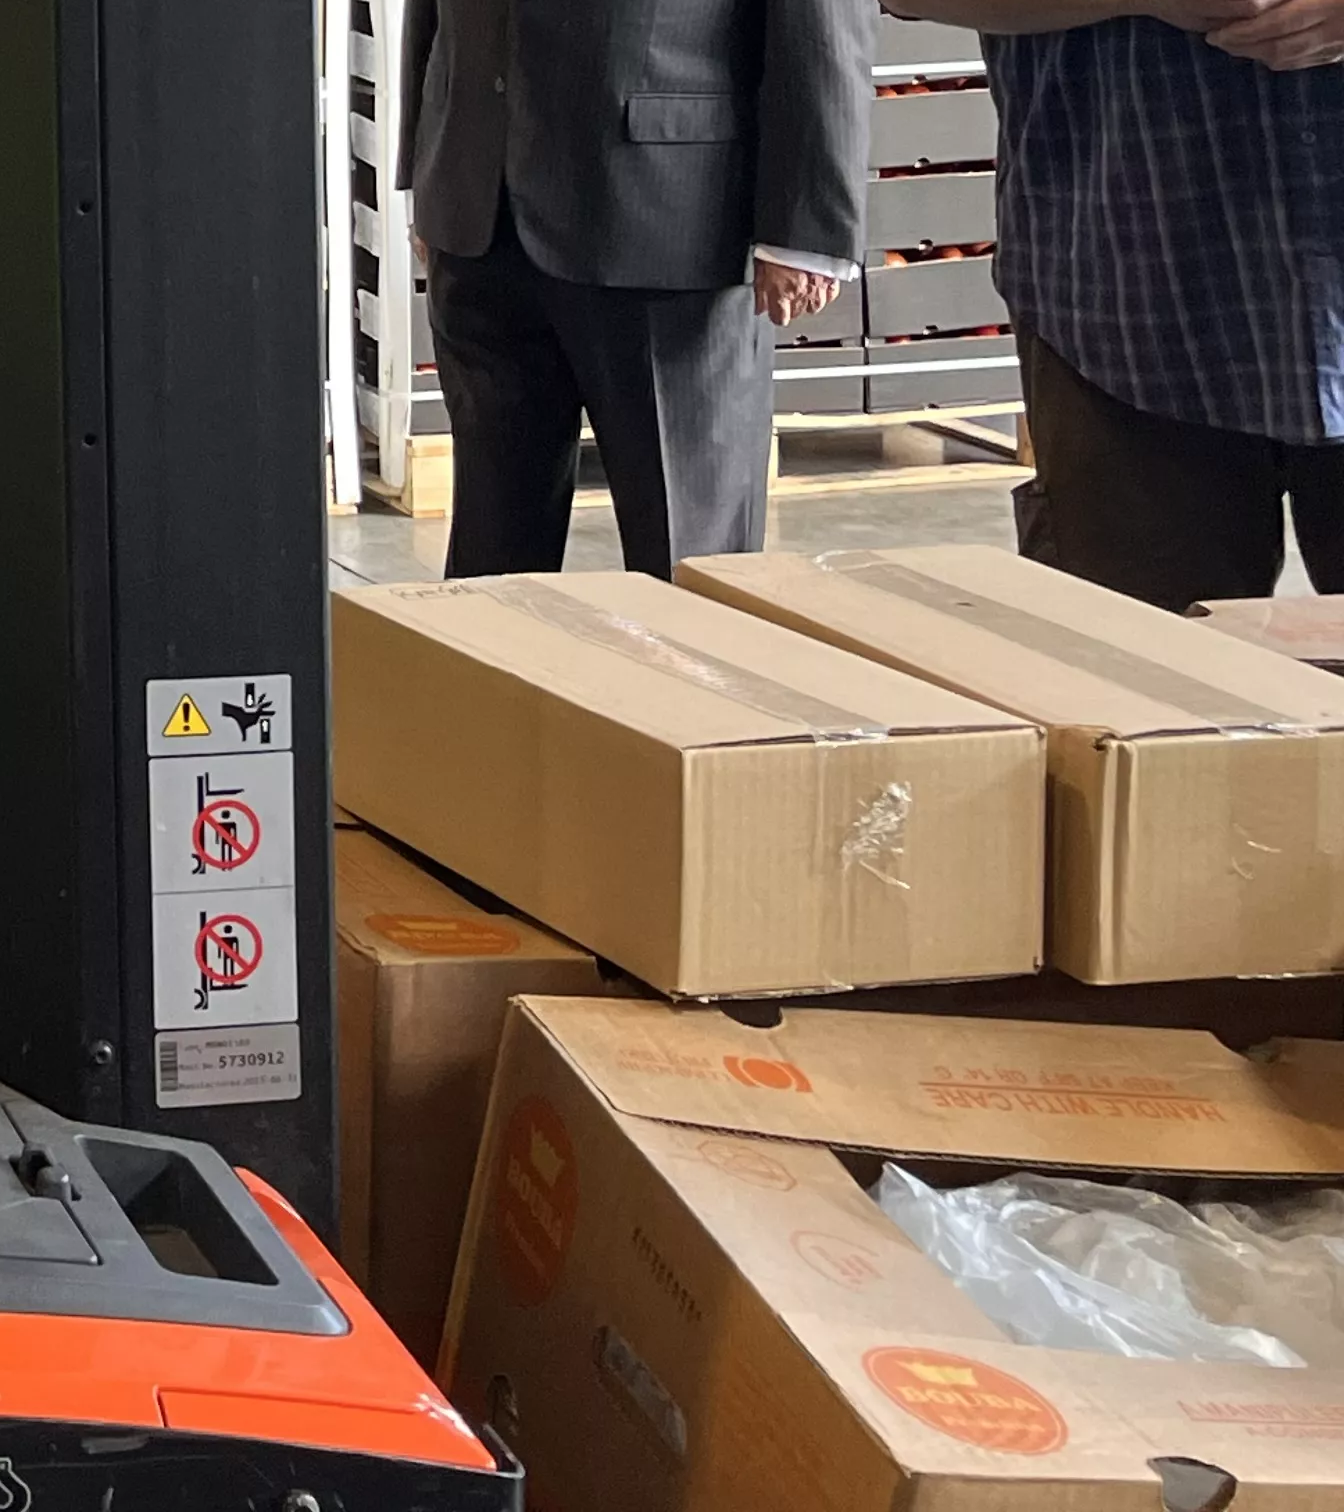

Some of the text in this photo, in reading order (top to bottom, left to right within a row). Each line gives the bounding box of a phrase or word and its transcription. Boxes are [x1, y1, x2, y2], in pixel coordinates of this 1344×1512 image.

[218, 1051, 285, 1070] 5730912
[924, 1088, 1227, 1123] HANDLE WITH CARE
[896, 1386, 1042, 1413] BOUBA
